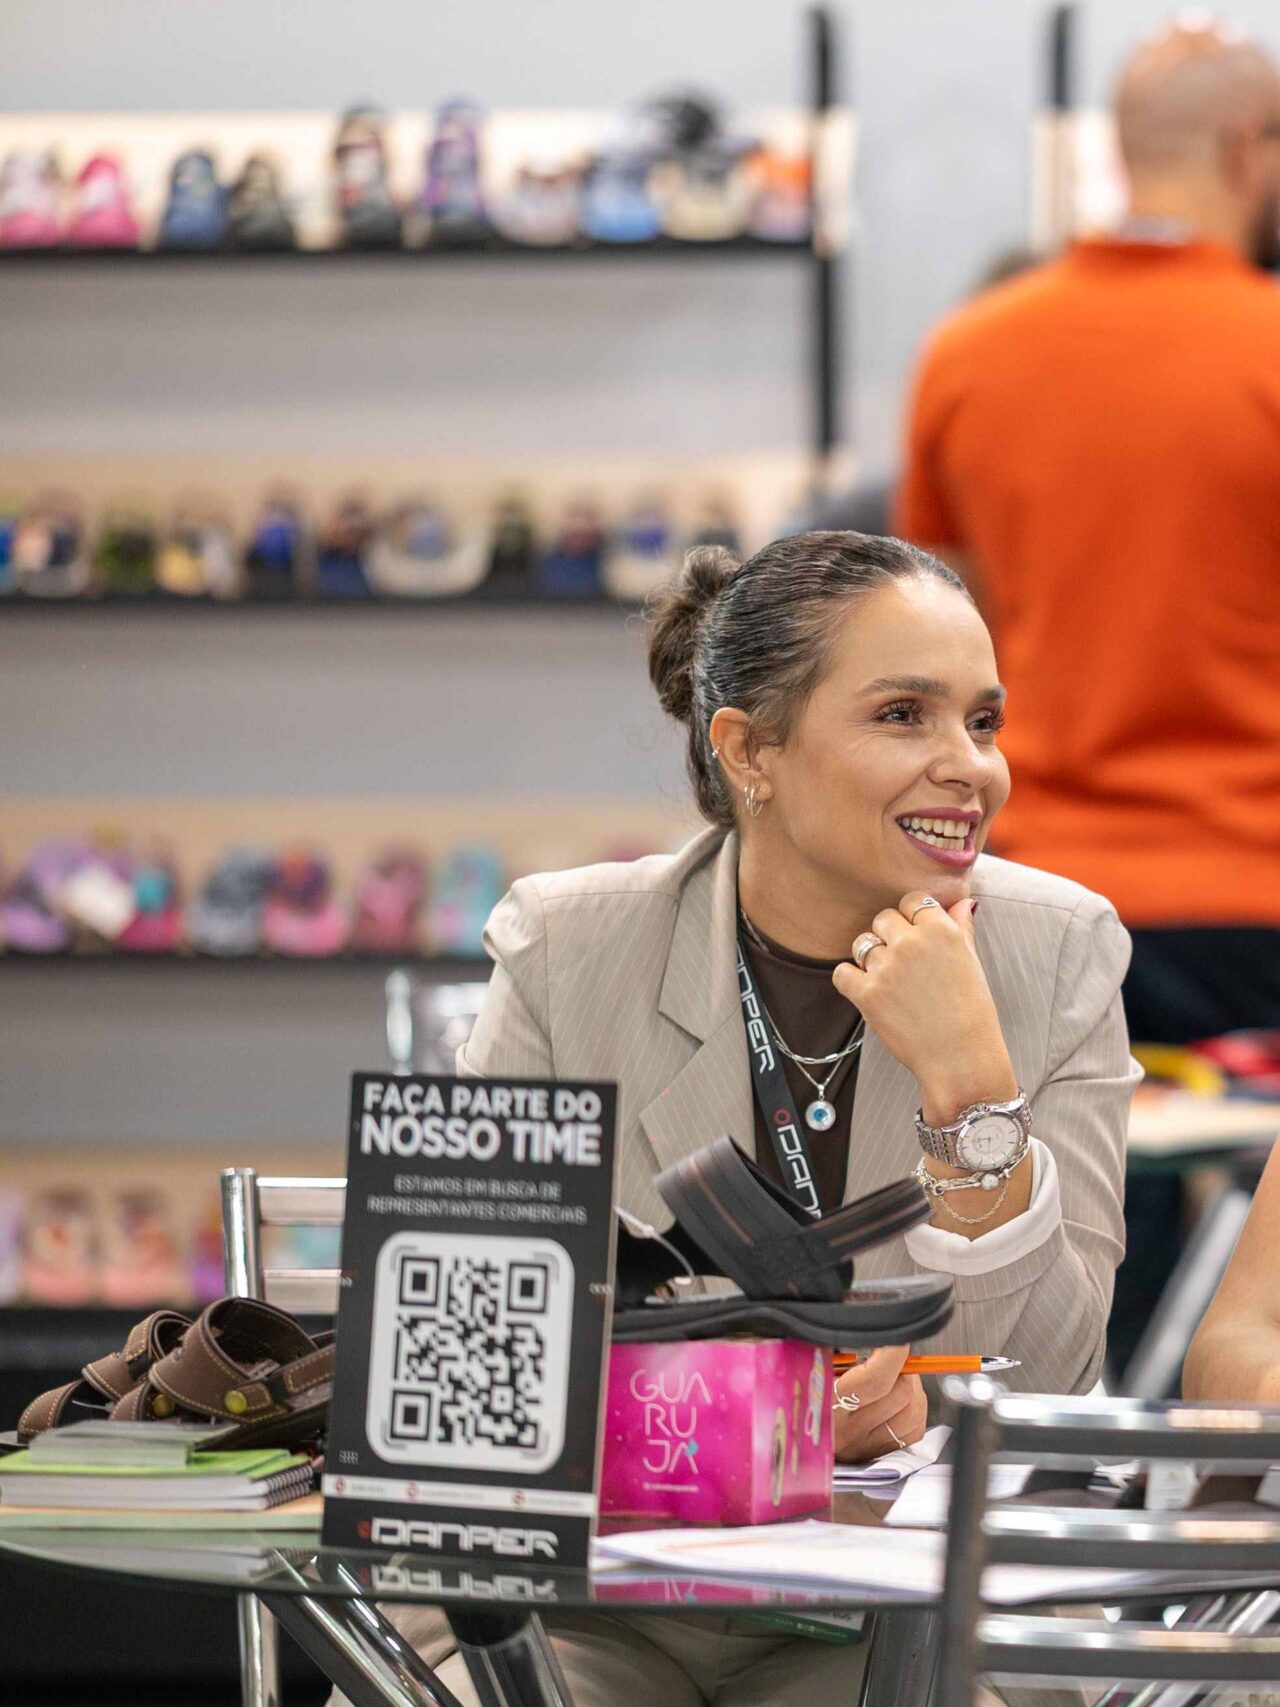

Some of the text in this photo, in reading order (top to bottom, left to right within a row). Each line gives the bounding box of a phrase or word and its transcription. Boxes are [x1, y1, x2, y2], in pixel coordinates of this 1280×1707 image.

[363, 1081, 603, 1122] FAÇA PARTE DO
[360, 1113, 603, 1167] NOSSO TIME
[393, 1174, 563, 1202] ESTAMOS EM BUSCA DE
[366, 1194, 497, 1221] REPRESENTANTES
[630, 1369, 713, 1405] GUA
[645, 1403, 698, 1438] RU
[370, 1516, 560, 1559] DANPER
